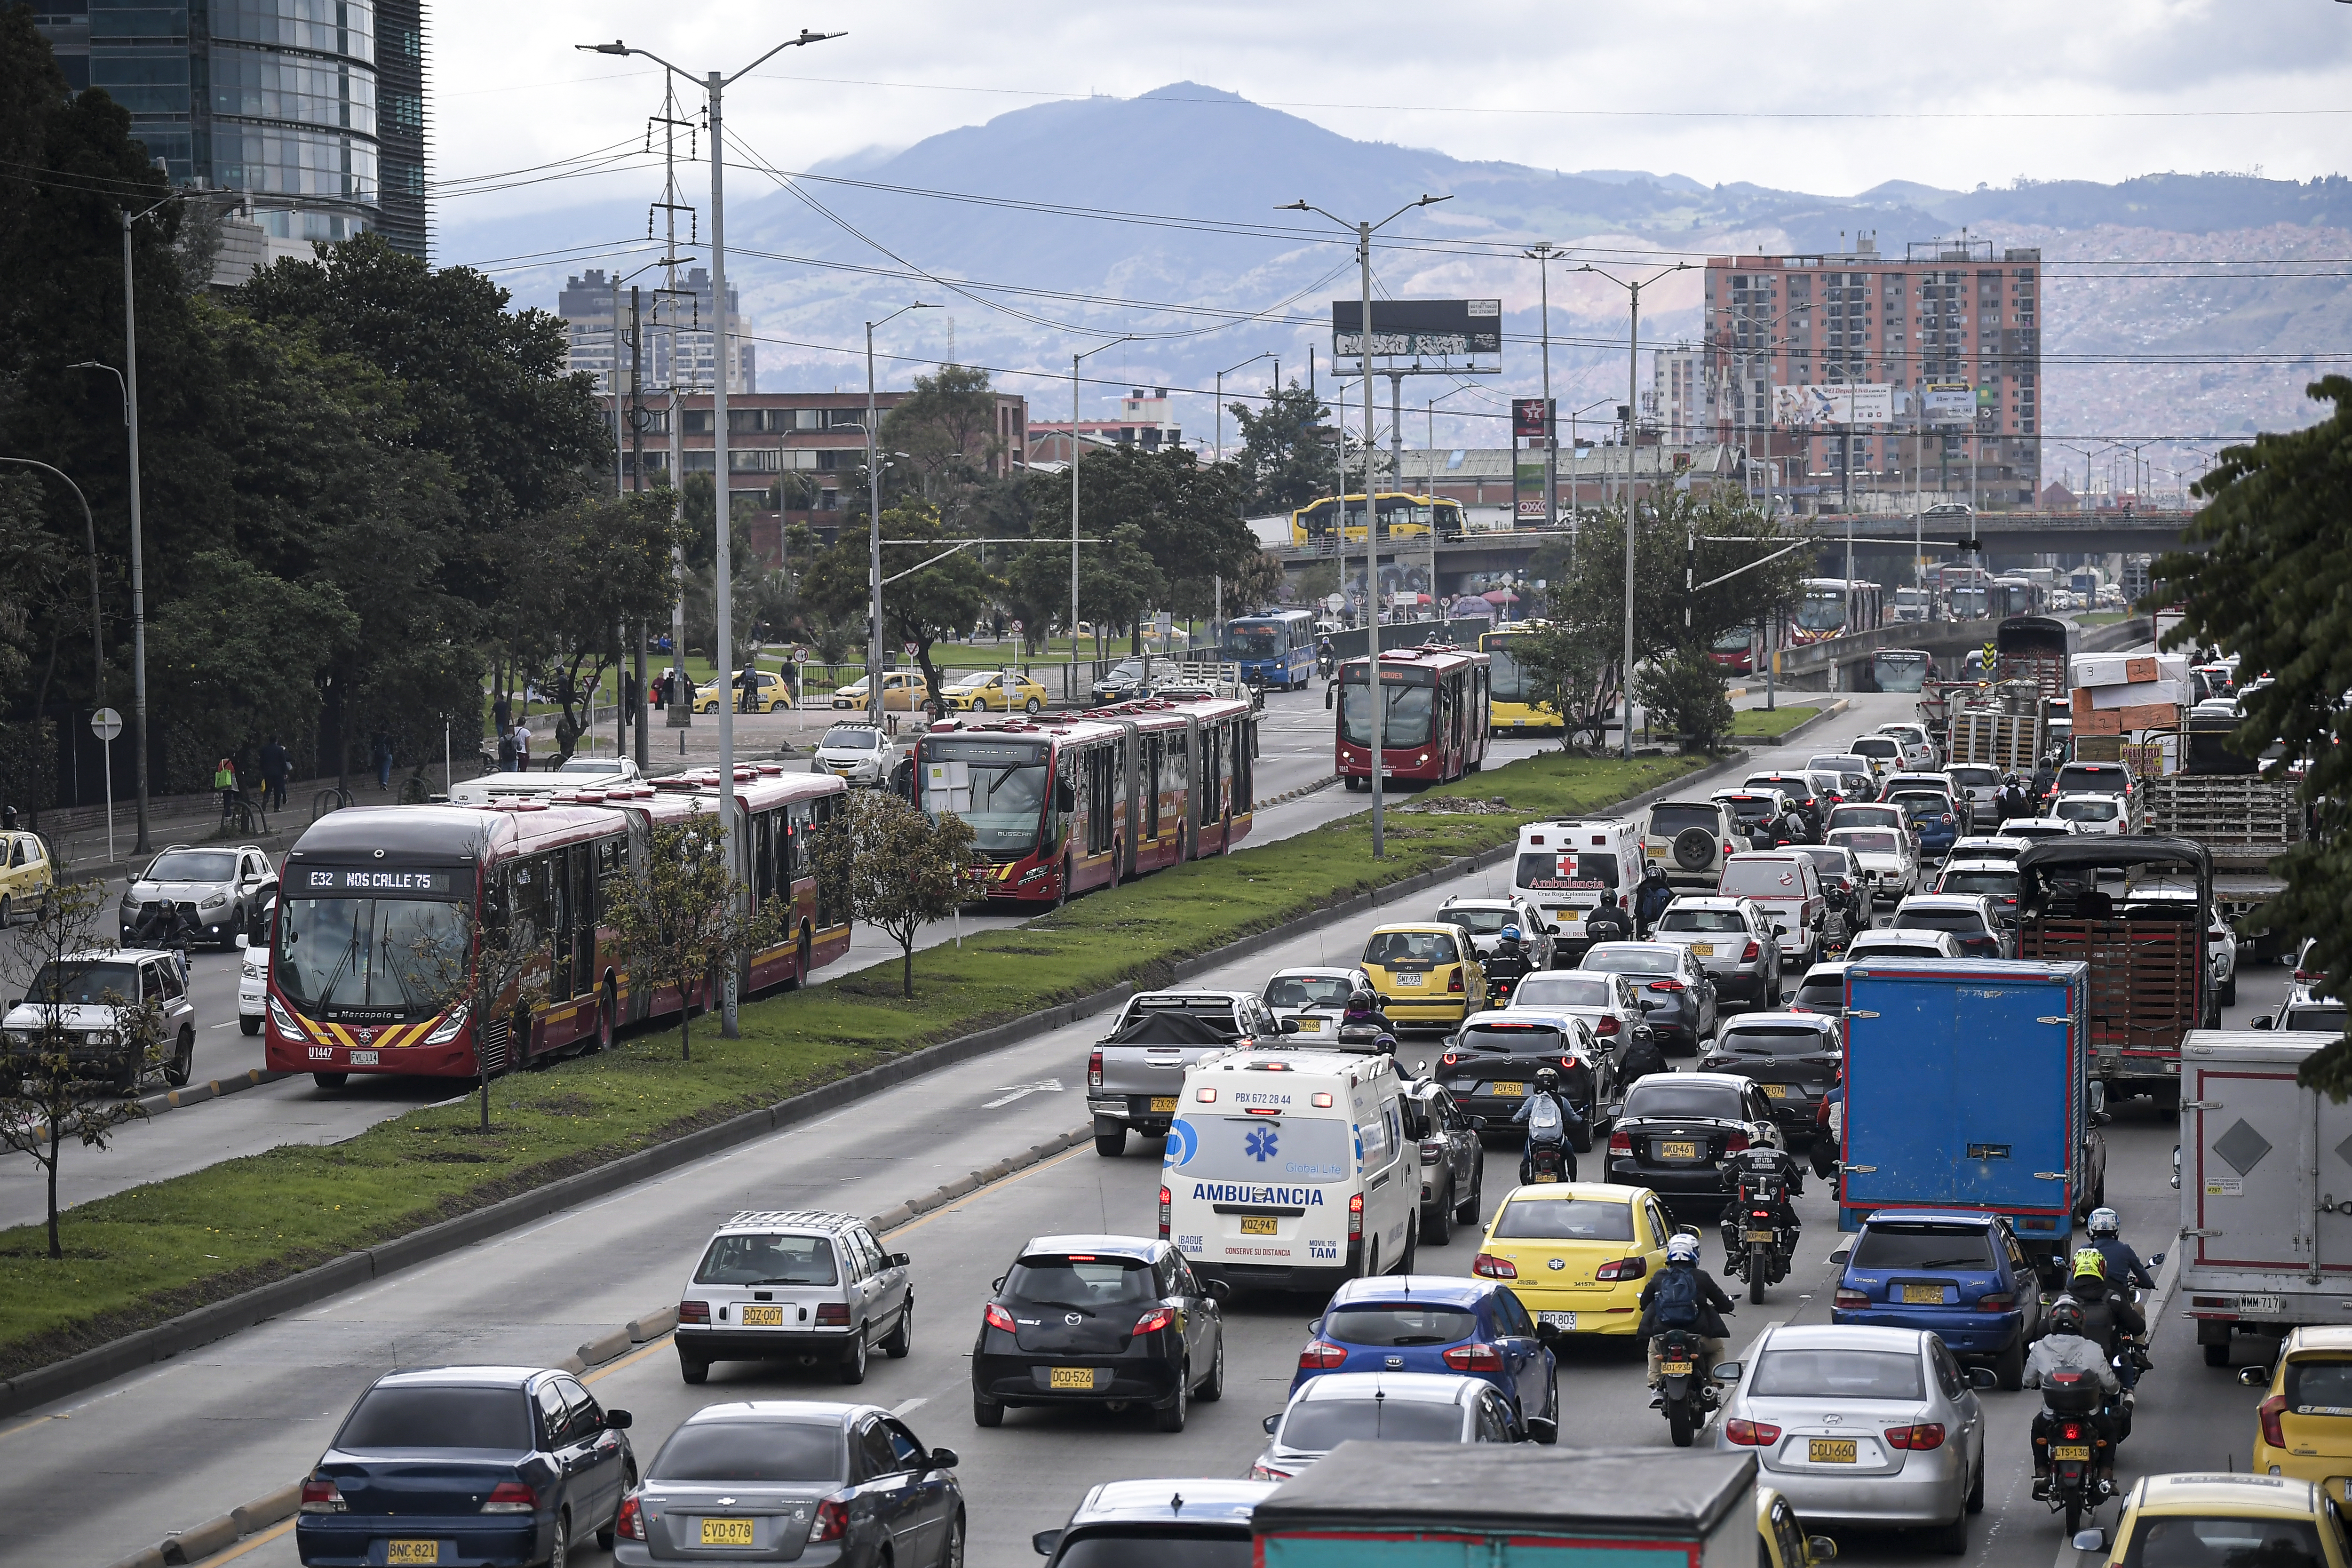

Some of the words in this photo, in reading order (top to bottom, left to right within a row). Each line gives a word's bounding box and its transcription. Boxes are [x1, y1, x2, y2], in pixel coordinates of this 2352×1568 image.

[2087, 667, 2094, 677] 3
[310, 872, 333, 886] E32
[347, 872, 371, 887] NQS
[373, 873, 411, 888] CALLE
[415, 874, 430, 888] 75
[1529, 877, 1605, 889] Ambulancia
[341, 1011, 392, 1019] Marcopolo
[309, 1047, 333, 1058] U1447
[1494, 1083, 1521, 1092] PDV-510
[1235, 1093, 1250, 1103] PBX
[1252, 1094, 1266, 1104] 672
[1269, 1094, 1280, 1104] 28
[1280, 1095, 1291, 1105] 44
[1286, 1162, 1319, 1174] Global
[1323, 1164, 1342, 1174] Life
[1192, 1183, 1325, 1206] AMBULANCIA
[1178, 1235, 1203, 1245] IBAGUE
[1310, 1247, 1337, 1259] TAM
[2241, 1297, 2279, 1309] WMM-717
[1811, 1443, 1855, 1457] CCU-660
[704, 1523, 751, 1537] CVD-878
[390, 1544, 435, 1558] BNC-821
